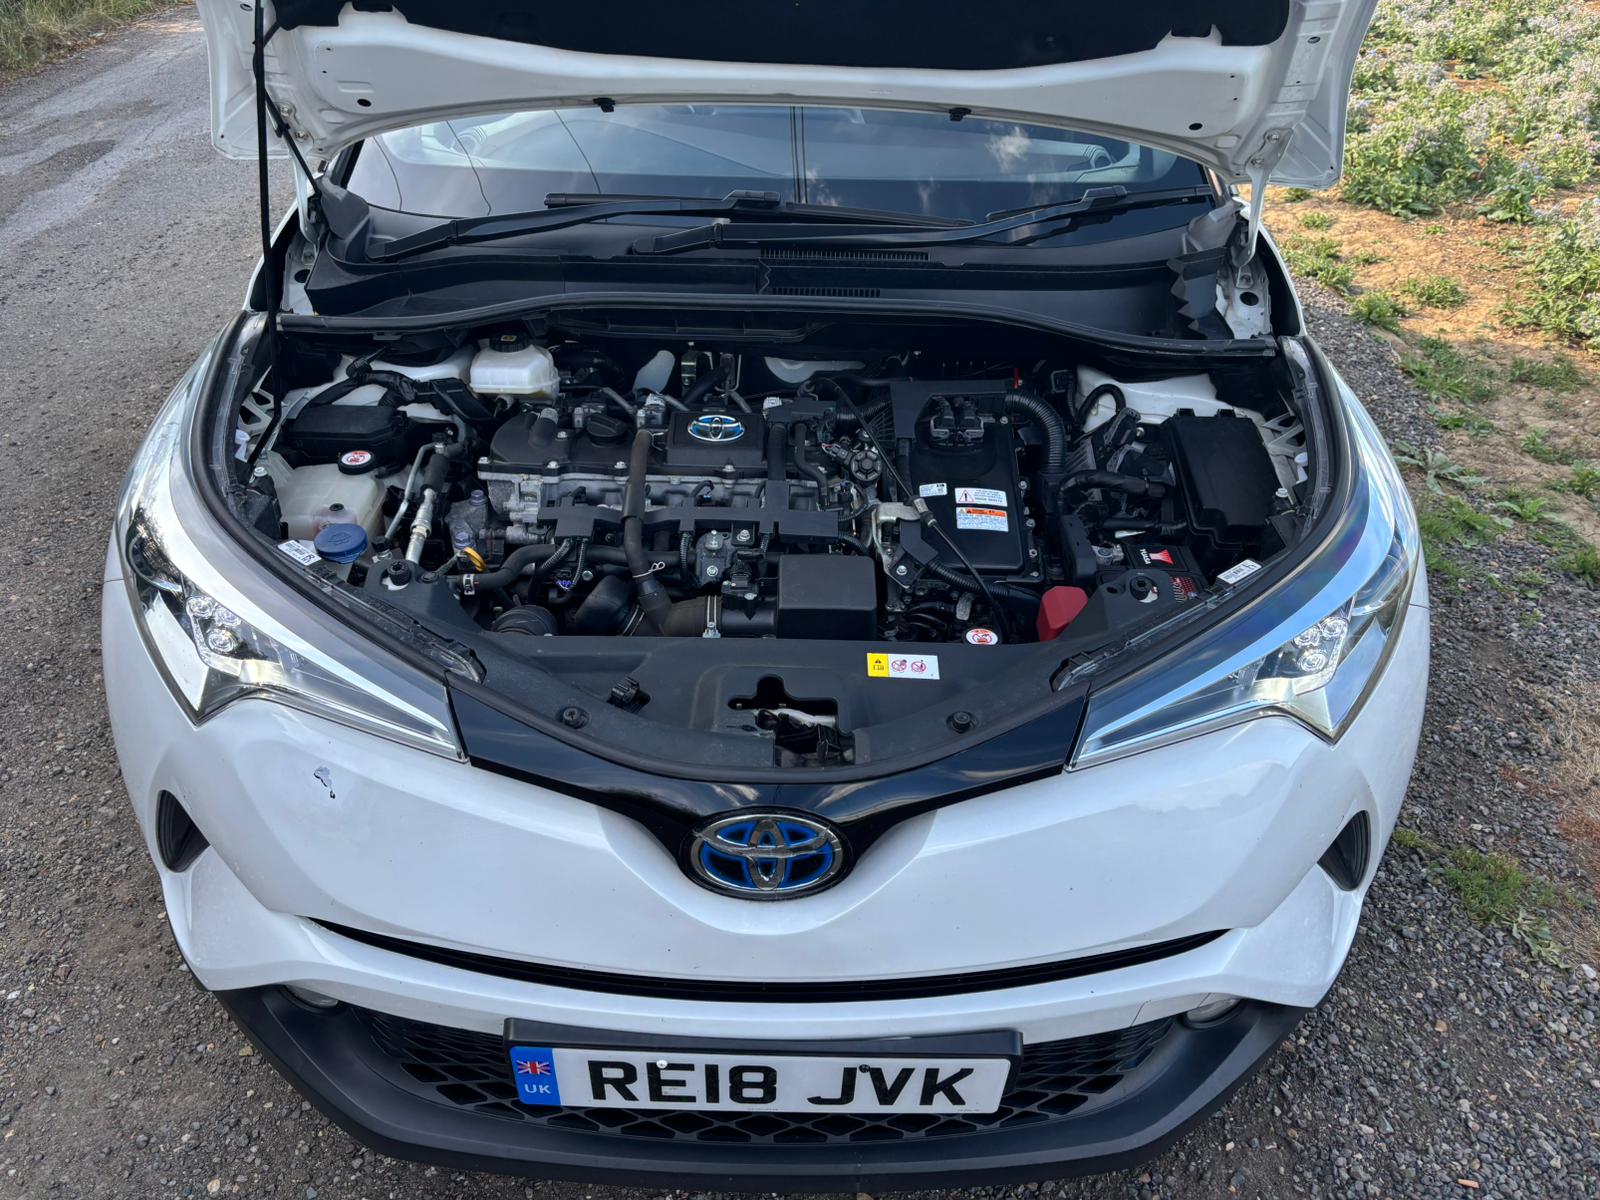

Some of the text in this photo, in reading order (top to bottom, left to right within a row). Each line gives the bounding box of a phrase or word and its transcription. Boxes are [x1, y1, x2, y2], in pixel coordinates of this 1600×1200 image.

[524, 1084, 551, 1094] UK
[588, 1060, 974, 1105] RE18 JVK
